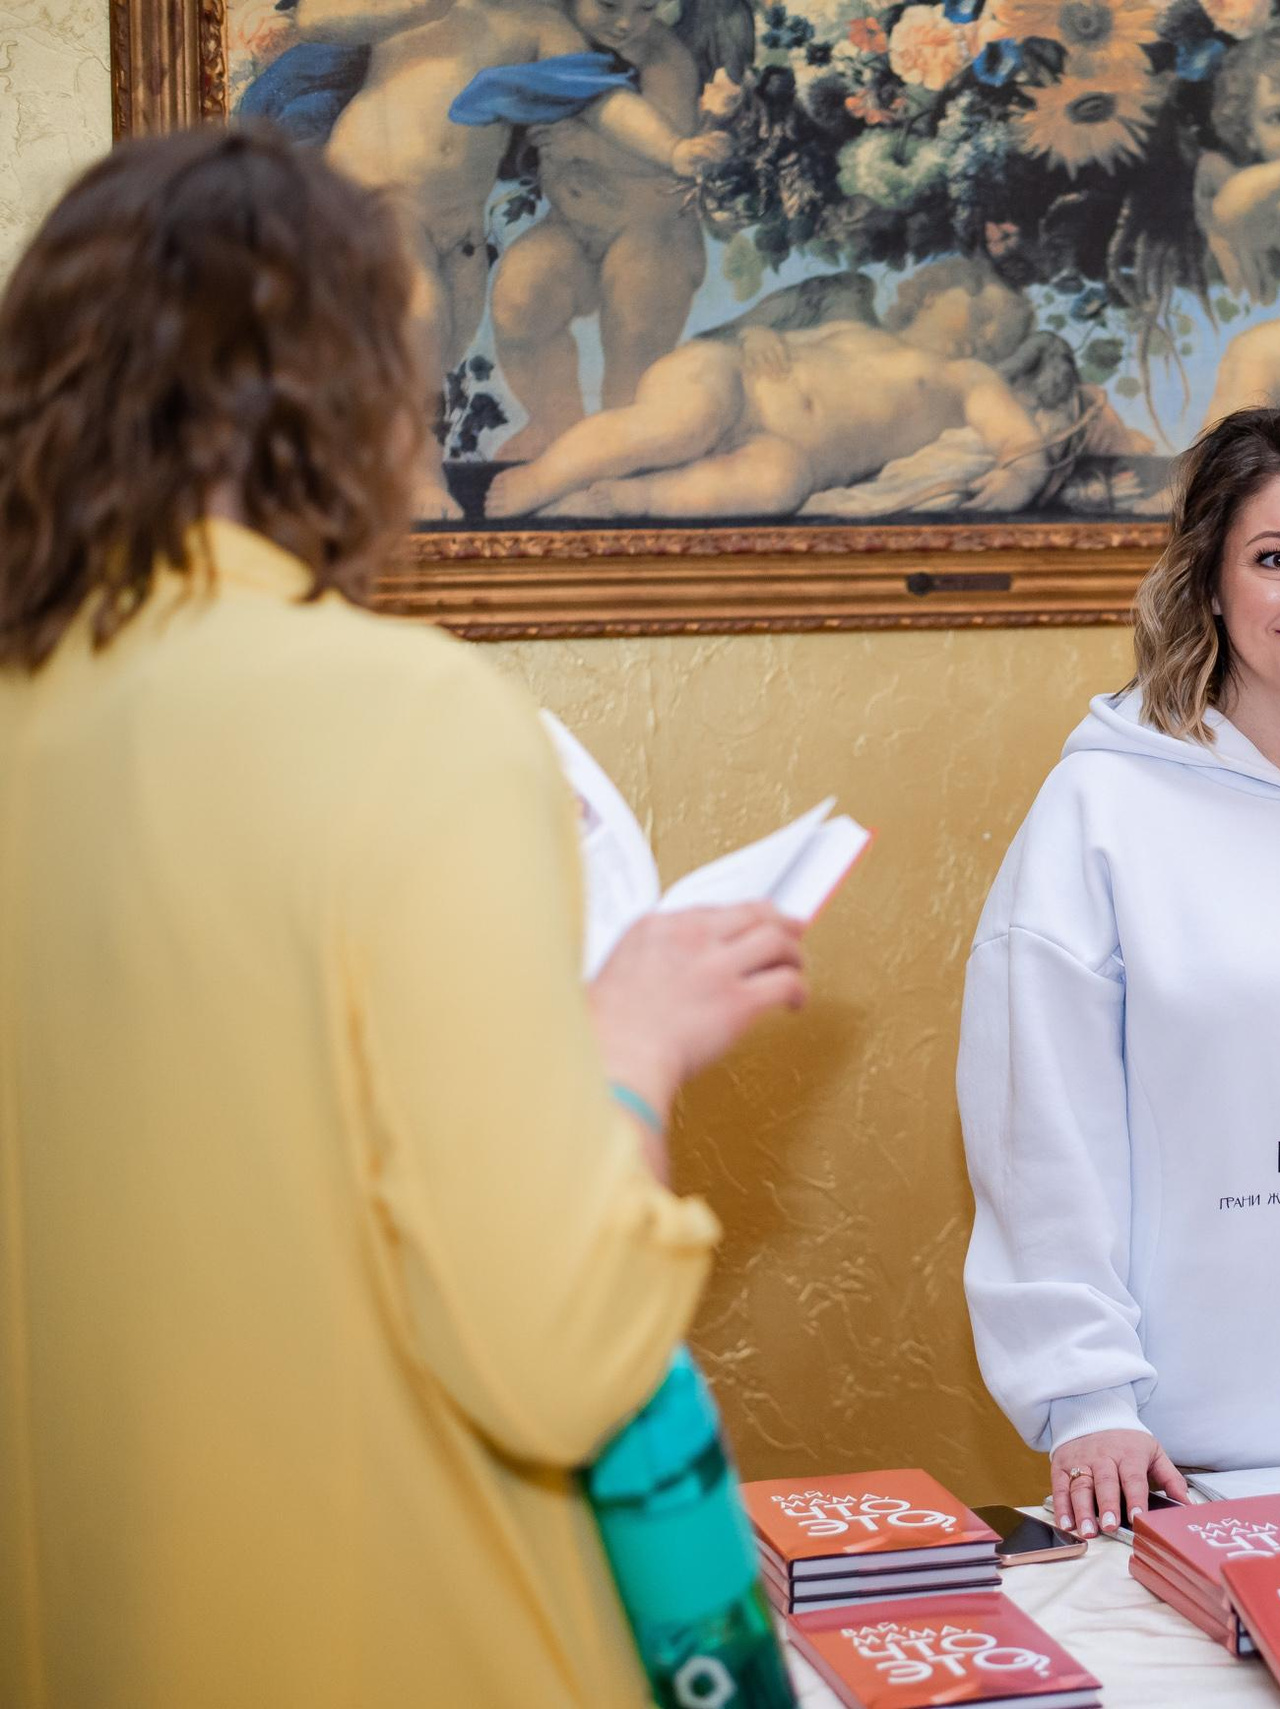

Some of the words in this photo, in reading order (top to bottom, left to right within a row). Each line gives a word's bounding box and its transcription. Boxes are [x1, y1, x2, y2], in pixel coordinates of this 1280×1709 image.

[1219, 1194, 1261, 1210] ГРАНИ
[780, 1493, 890, 1510] МАМА,
[783, 1499, 911, 1520] ЧТО
[798, 1510, 957, 1537] ЭТО?
[852, 1624, 973, 1647] МАМА,
[857, 1632, 998, 1661] ЧТО
[875, 1647, 1052, 1684] ЭТО?
